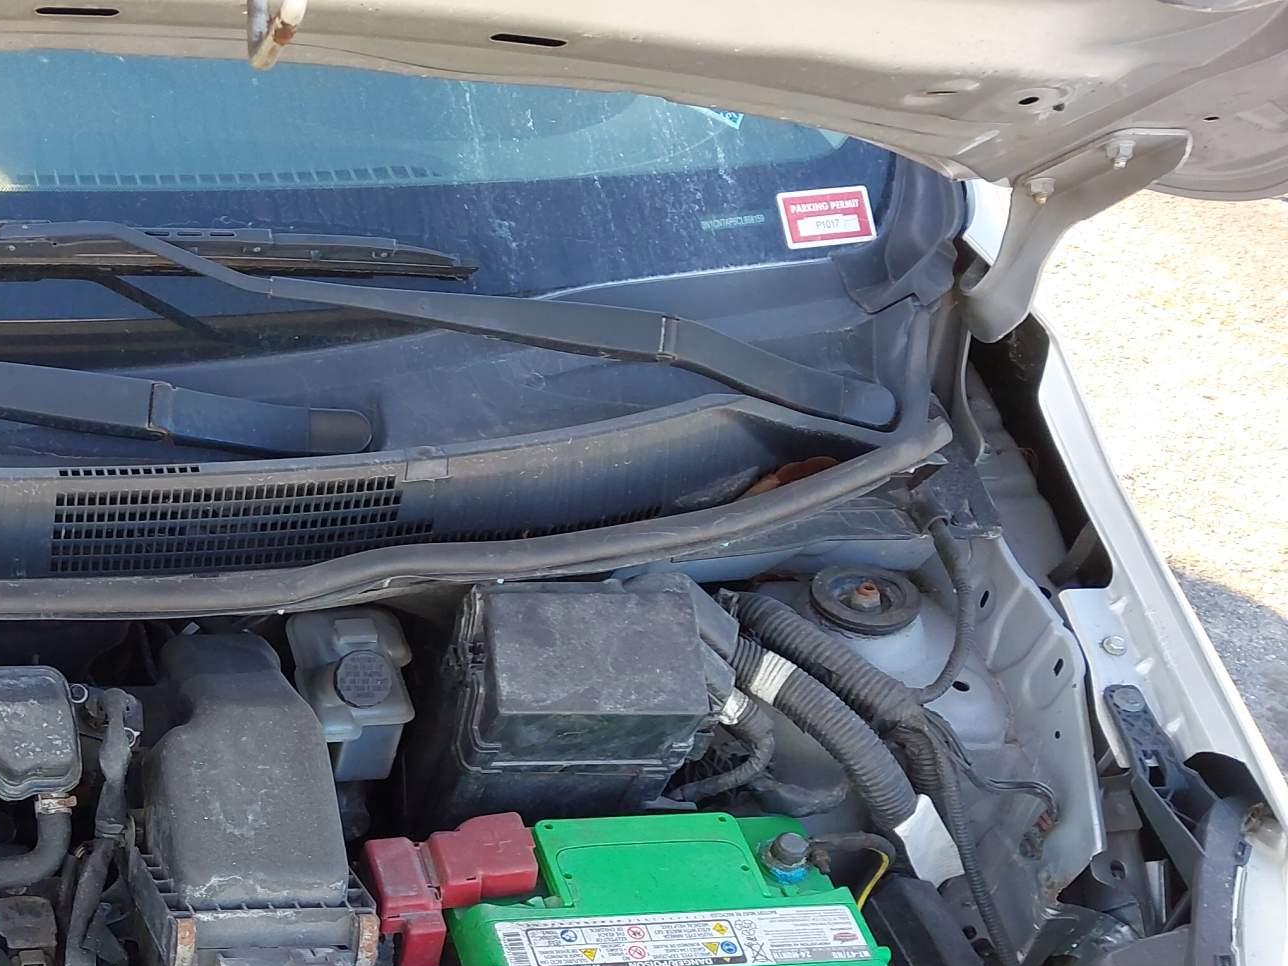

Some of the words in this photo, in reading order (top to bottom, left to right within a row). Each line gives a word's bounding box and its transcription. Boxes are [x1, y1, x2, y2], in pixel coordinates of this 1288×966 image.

[790, 201, 829, 213] PARKING
[830, 198, 859, 210] PERMIT
[815, 219, 840, 229] P1017
